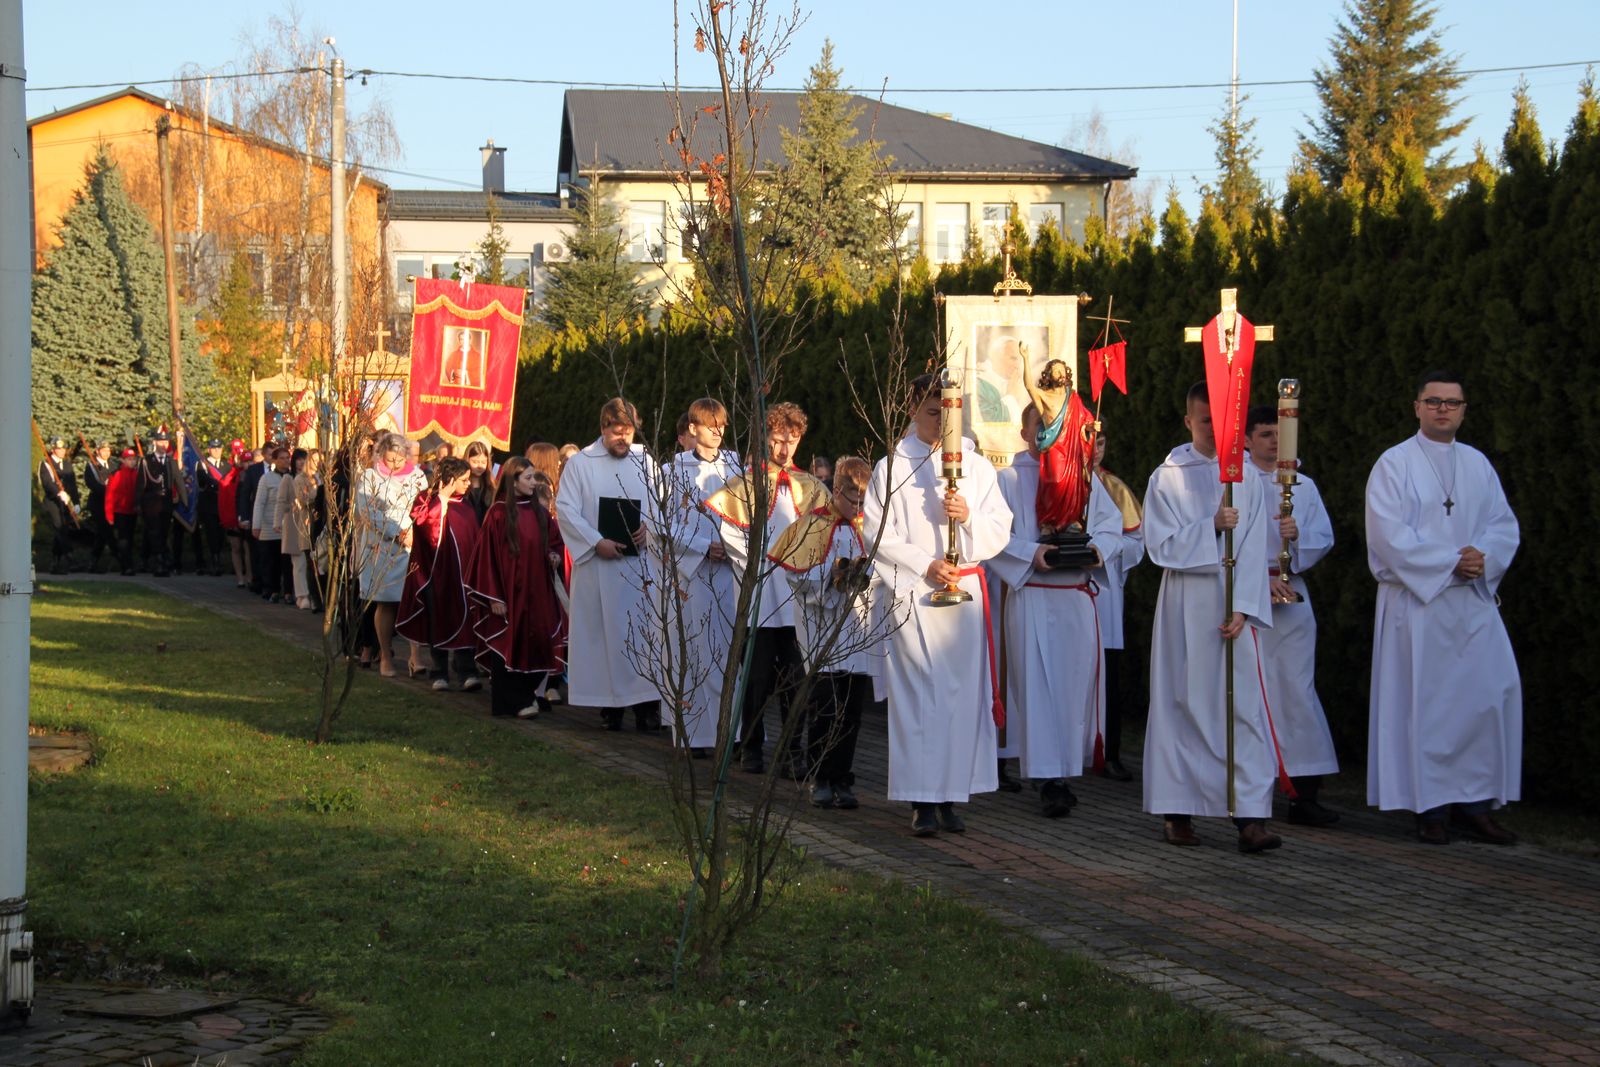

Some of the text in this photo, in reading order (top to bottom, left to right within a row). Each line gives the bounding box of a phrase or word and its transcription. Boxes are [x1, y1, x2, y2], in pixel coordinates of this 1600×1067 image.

[420, 394, 459, 406] WSTAWIAJ
[472, 399, 482, 409] ZA
[484, 401, 502, 411] NAMI
